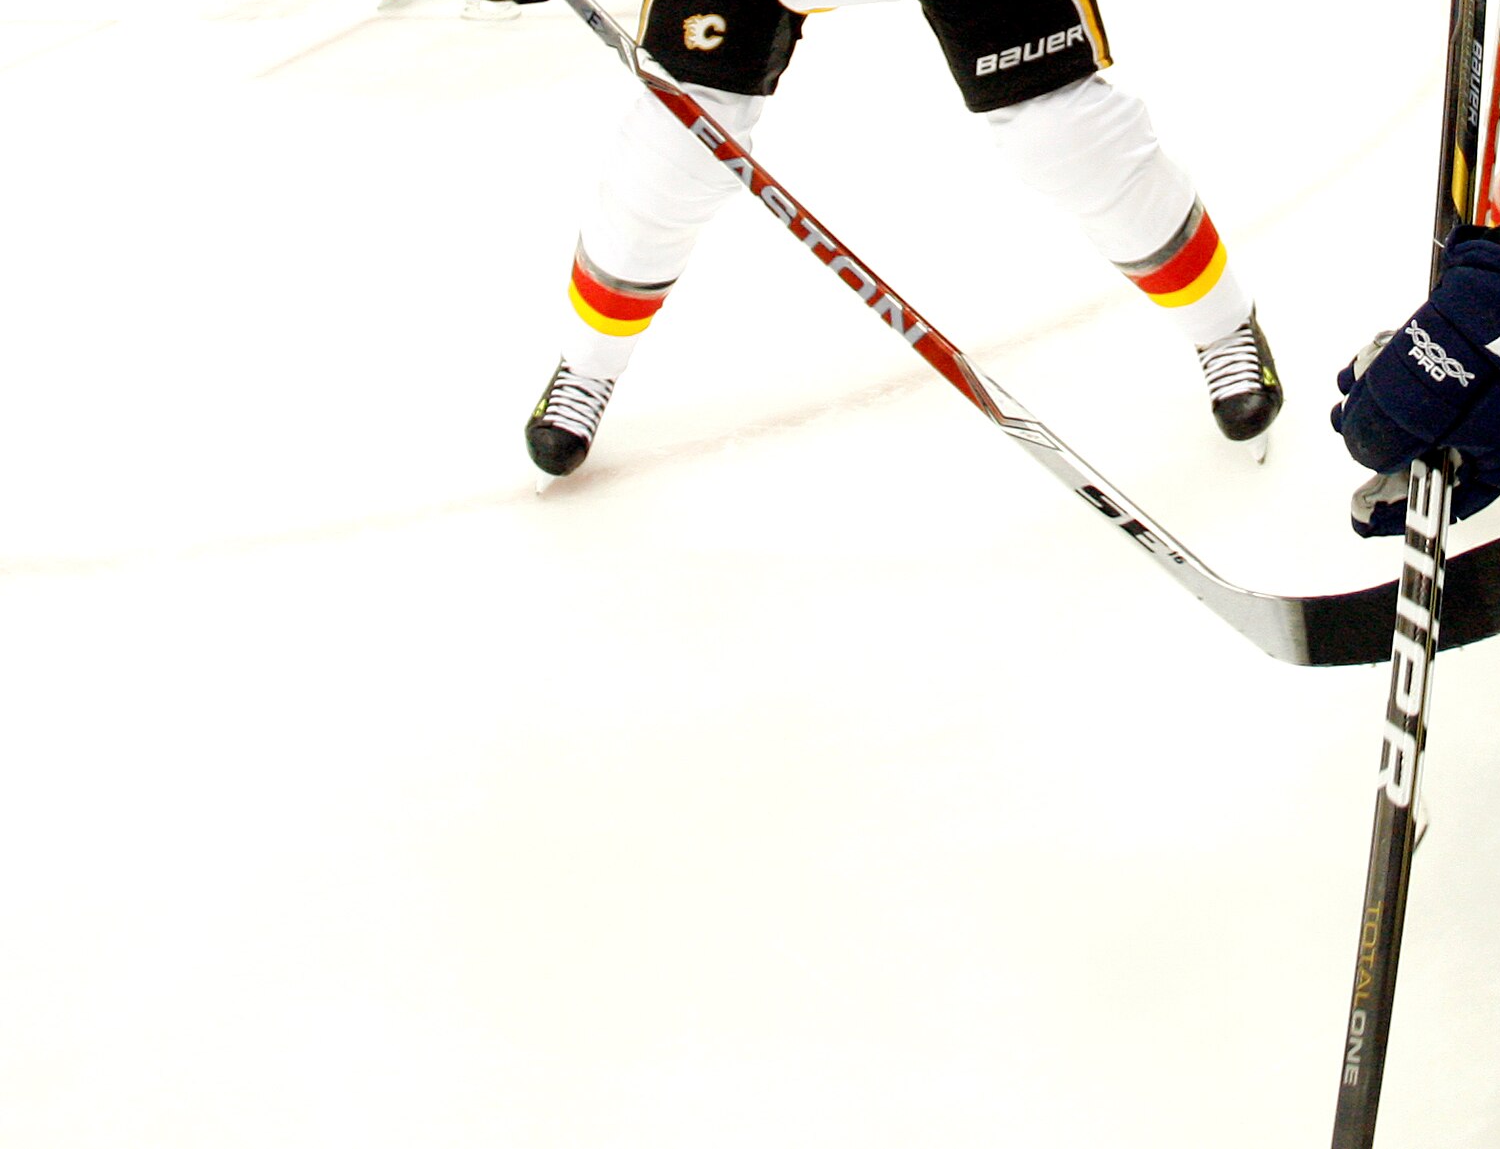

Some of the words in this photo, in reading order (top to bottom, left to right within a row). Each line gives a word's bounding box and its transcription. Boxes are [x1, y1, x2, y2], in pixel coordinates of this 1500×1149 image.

[690, 114, 930, 346] EASTON
[1407, 345, 1447, 383] PRO
[1343, 1008, 1367, 1087] ONE
